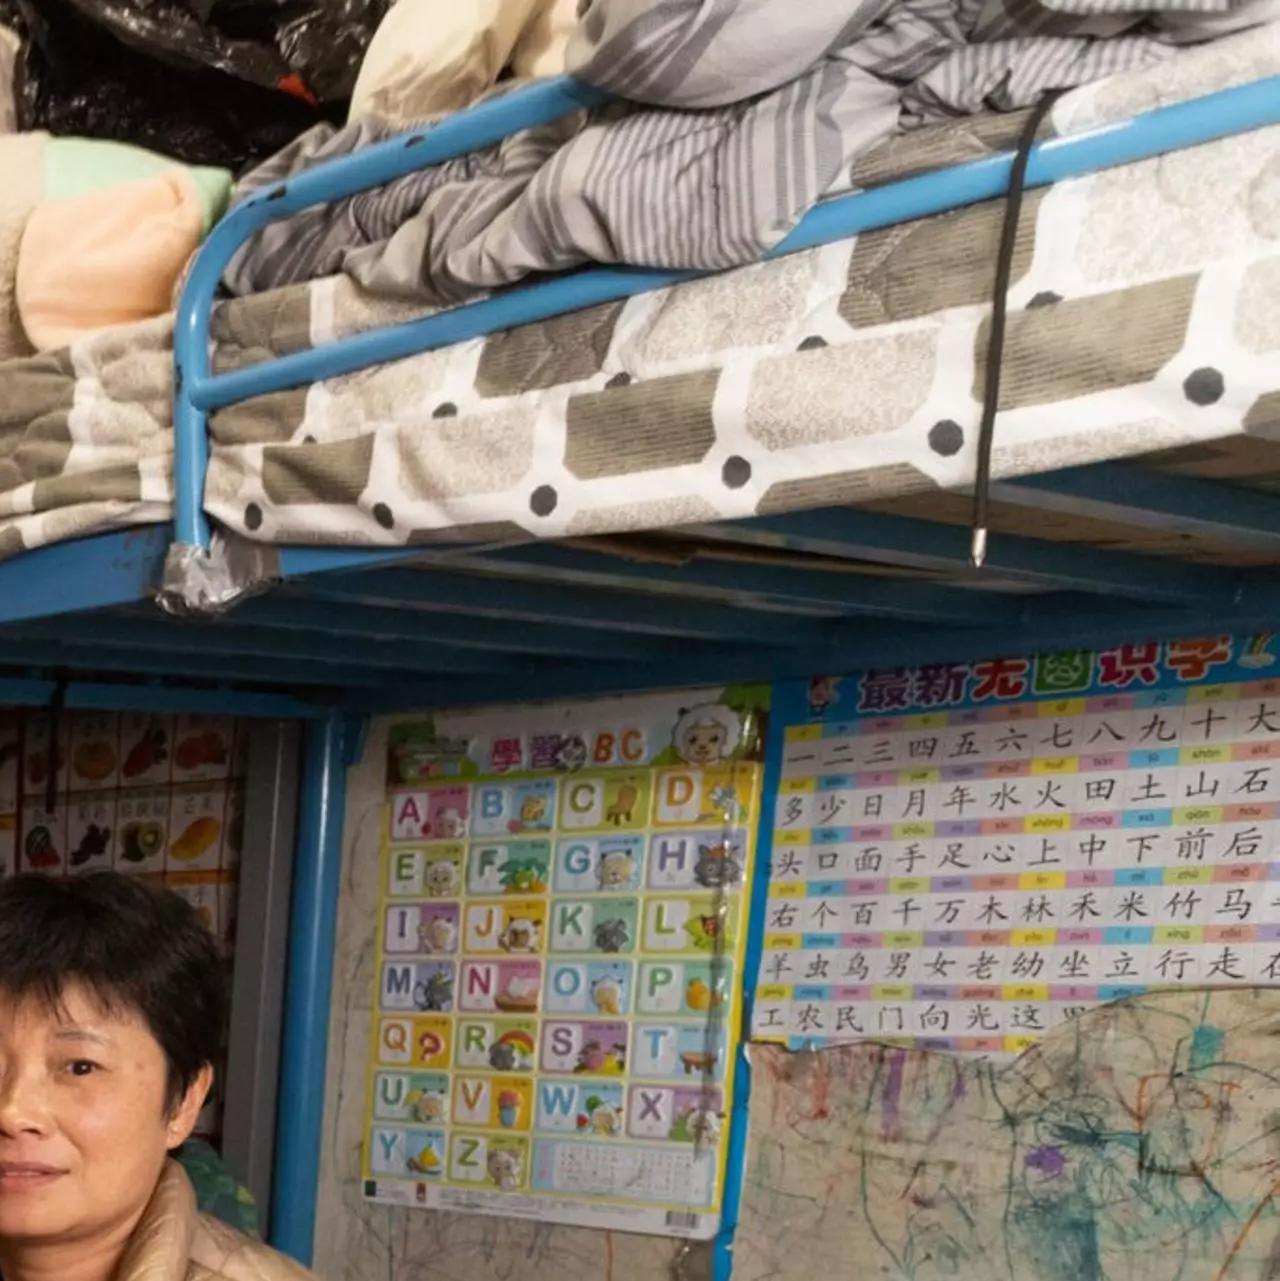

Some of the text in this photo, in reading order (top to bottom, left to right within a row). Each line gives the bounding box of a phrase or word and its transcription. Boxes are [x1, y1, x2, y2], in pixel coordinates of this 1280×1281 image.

[398, 781, 694, 825] A B C D
[396, 843, 686, 879] E F G H
[396, 907, 673, 938] I J K L
[771, 888, 1280, 929] 右个百千万木林禾米竹马
[387, 967, 673, 998] M N O P
[383, 1023, 667, 1058] Q R S T
[382, 1079, 664, 1120] U V W X
[378, 1133, 479, 1165] Y Z
